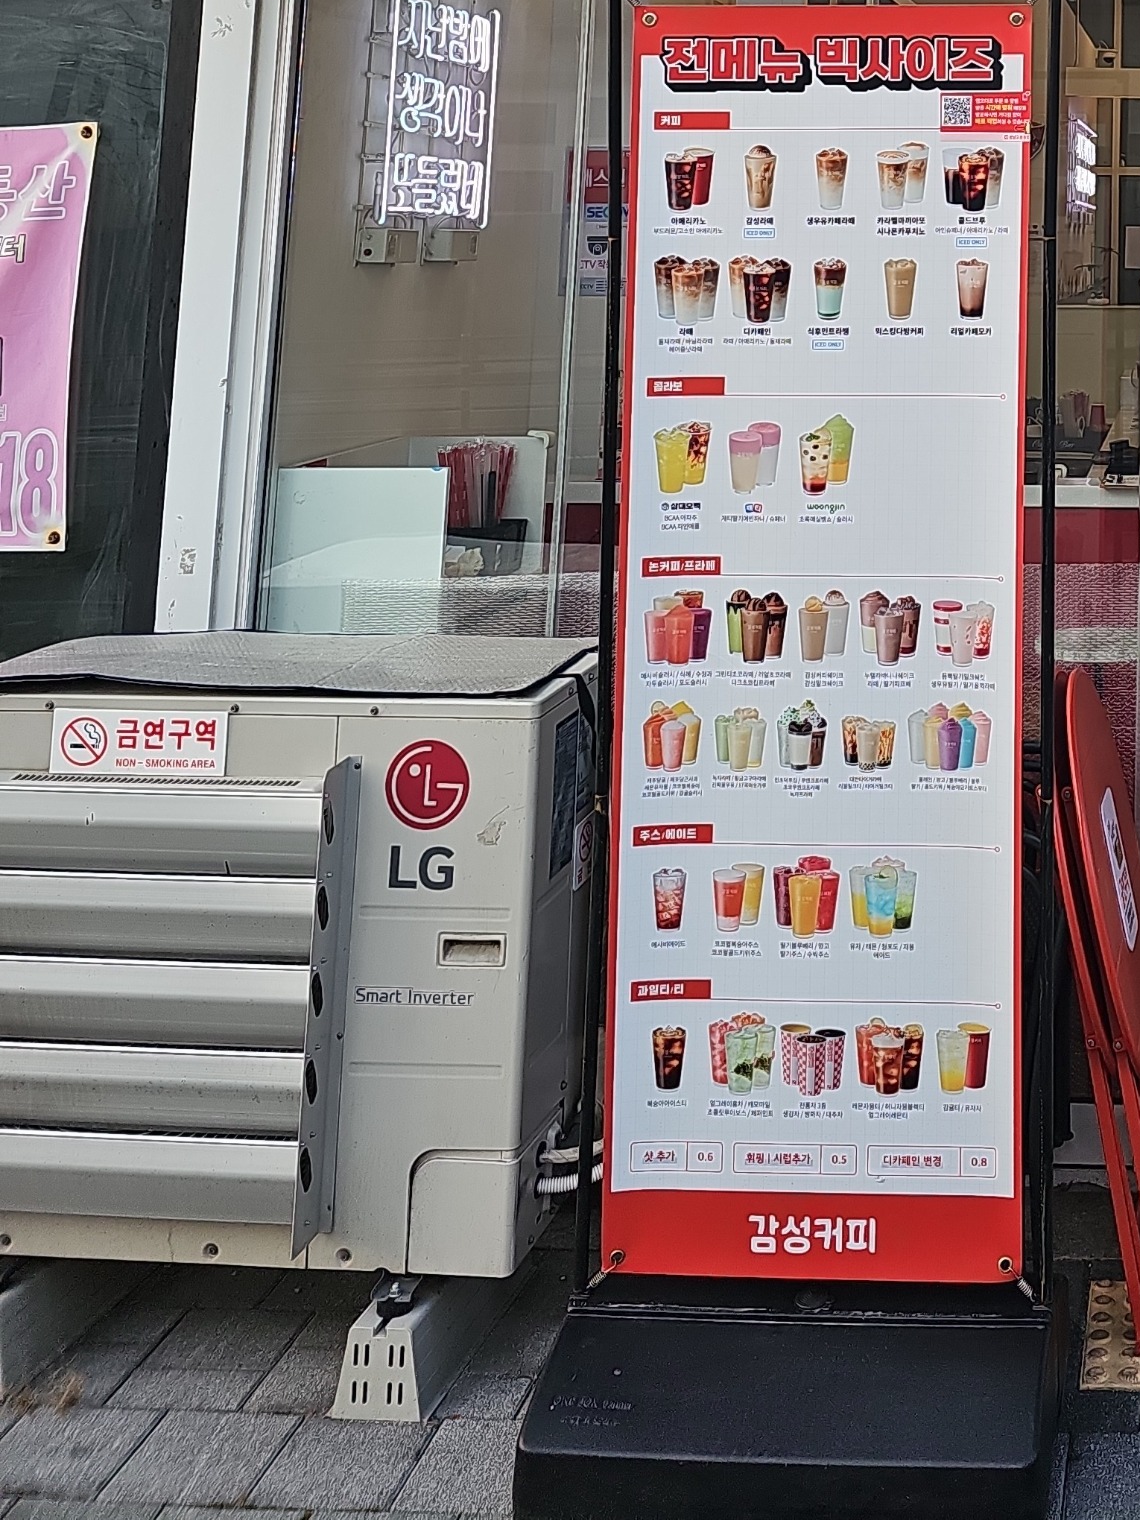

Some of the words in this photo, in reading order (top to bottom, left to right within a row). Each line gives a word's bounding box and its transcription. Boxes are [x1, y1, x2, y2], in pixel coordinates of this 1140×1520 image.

[663, 37, 803, 82] 전메뉴
[815, 36, 994, 82] 빅사이즈
[659, 114, 681, 127] 커피
[670, 217, 707, 226] 아메리카노
[746, 217, 774, 226] 감성라떼
[678, 327, 694, 336] 라떼
[743, 327, 772, 336] 디카페인
[652, 380, 683, 392] 콜라보
[806, 503, 846, 514] woongjin
[116, 718, 217, 752] 금연구역
[190, 758, 216, 769] AREA
[639, 827, 697, 841] 주스/에이드
[388, 845, 455, 891] LG
[355, 987, 401, 1005] Smart
[408, 988, 474, 1007] Inverter
[643, 1150, 654, 1162] 샷
[656, 1150, 675, 1162] 추가
[697, 1151, 714, 1162] 0.6
[745, 1152, 765, 1165] 휘핑
[773, 1152, 811, 1165] 시럽추가
[831, 1154, 847, 1165] 0.5
[882, 1154, 921, 1166] 디카페인
[923, 1155, 943, 1167] 변경
[970, 1157, 988, 1167] 0.8
[748, 1215, 877, 1255] 감성커피
